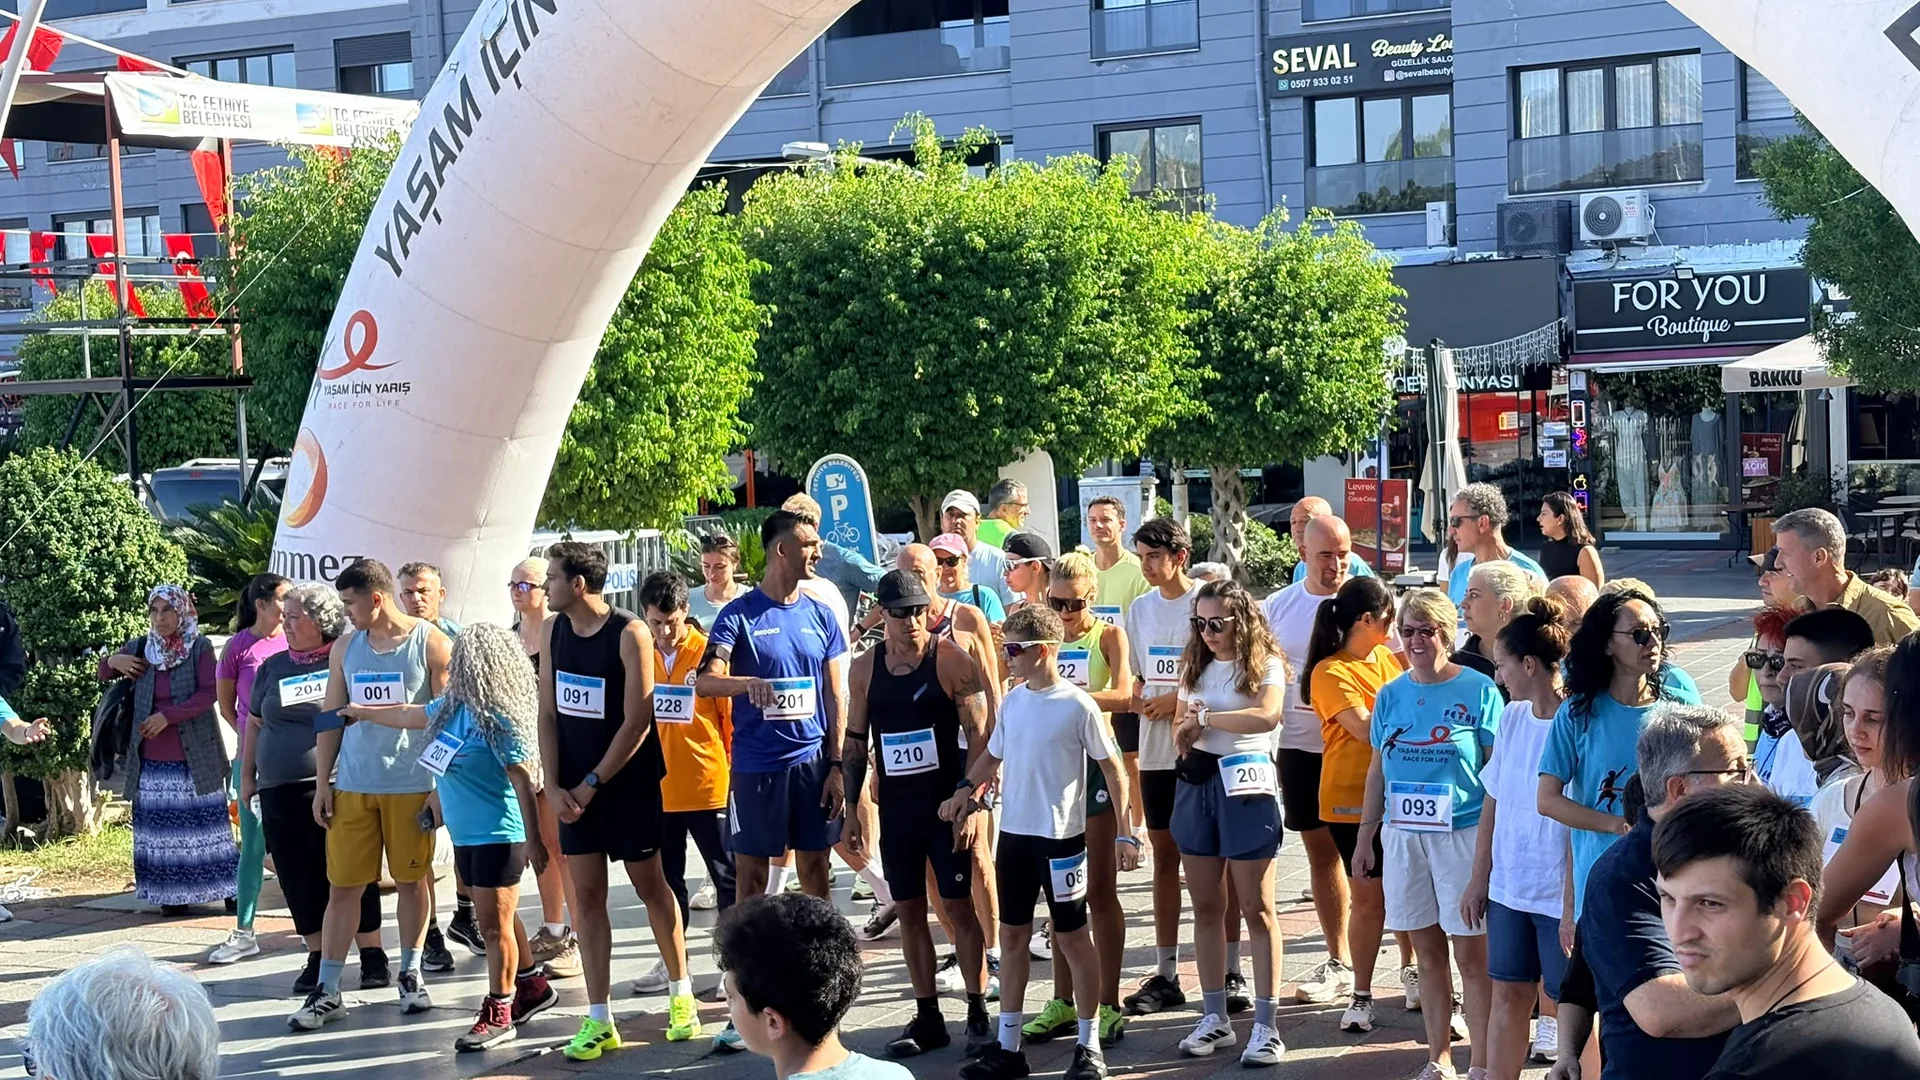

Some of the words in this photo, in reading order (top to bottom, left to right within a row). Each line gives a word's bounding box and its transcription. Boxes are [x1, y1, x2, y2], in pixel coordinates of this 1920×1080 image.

[1371, 39, 1424, 57] Beauty
[1272, 43, 1357, 75] SEVAL
[1391, 56, 1430, 67] GÜZELLİK
[1290, 79, 1311, 89] 0507
[1312, 77, 1329, 87] 933
[1330, 76, 1342, 85] 02
[1343, 75, 1354, 84] 51
[180, 93, 201, 109] T.C.
[374, 73, 482, 278] YAŞAM
[1612, 280, 1682, 313] FOR
[1690, 274, 1766, 311] YOU
[1647, 315, 1731, 343] Boutique
[1749, 370, 1802, 387] BAKKU
[324, 384, 349, 399] YAŞAM
[351, 381, 372, 398] İÇİN
[375, 382, 411, 395] YARIŞ
[376, 399, 400, 407] LIFE
[1347, 482, 1376, 491] Levrek
[830, 494, 848, 521] P
[294, 683, 323, 697] 204
[364, 686, 391, 700] 001
[563, 687, 590, 706] 091
[655, 697, 682, 713] 228
[777, 694, 804, 710] 201
[430, 745, 447, 762] 207
[893, 746, 924, 764] 210
[1236, 767, 1266, 783] 208
[1402, 798, 1436, 817] 093
[1065, 868, 1086, 888] 08
